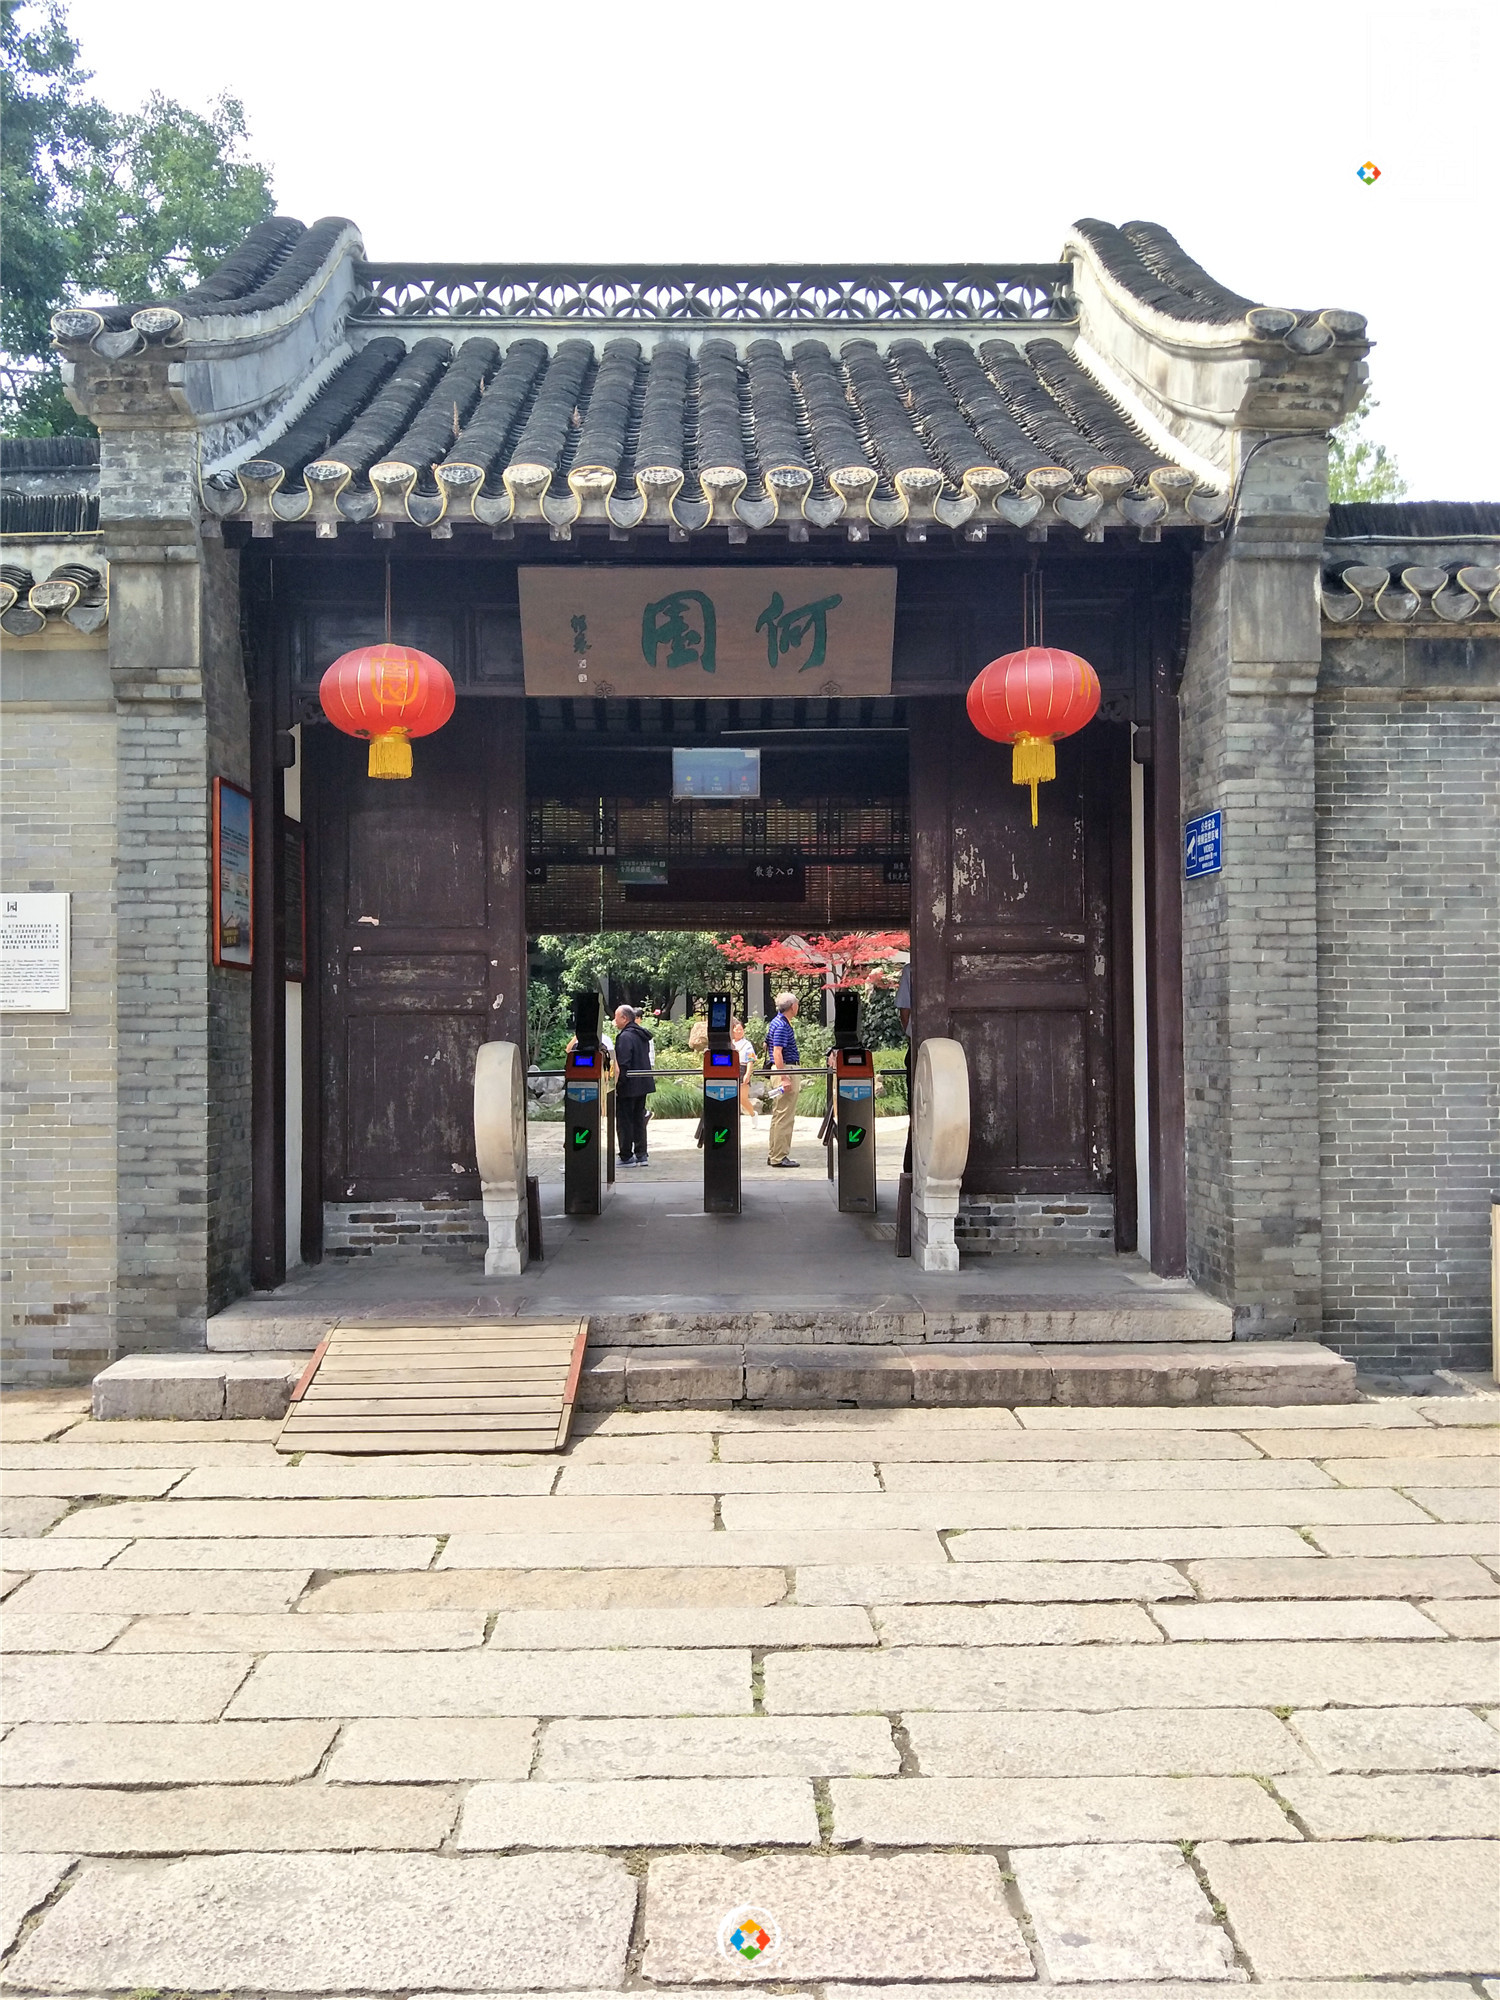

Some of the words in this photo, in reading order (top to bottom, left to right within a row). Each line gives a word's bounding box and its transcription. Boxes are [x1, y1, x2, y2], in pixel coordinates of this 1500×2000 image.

[1203, 843, 1215, 854] VIDEO
[754, 865, 794, 878] 散客入口
